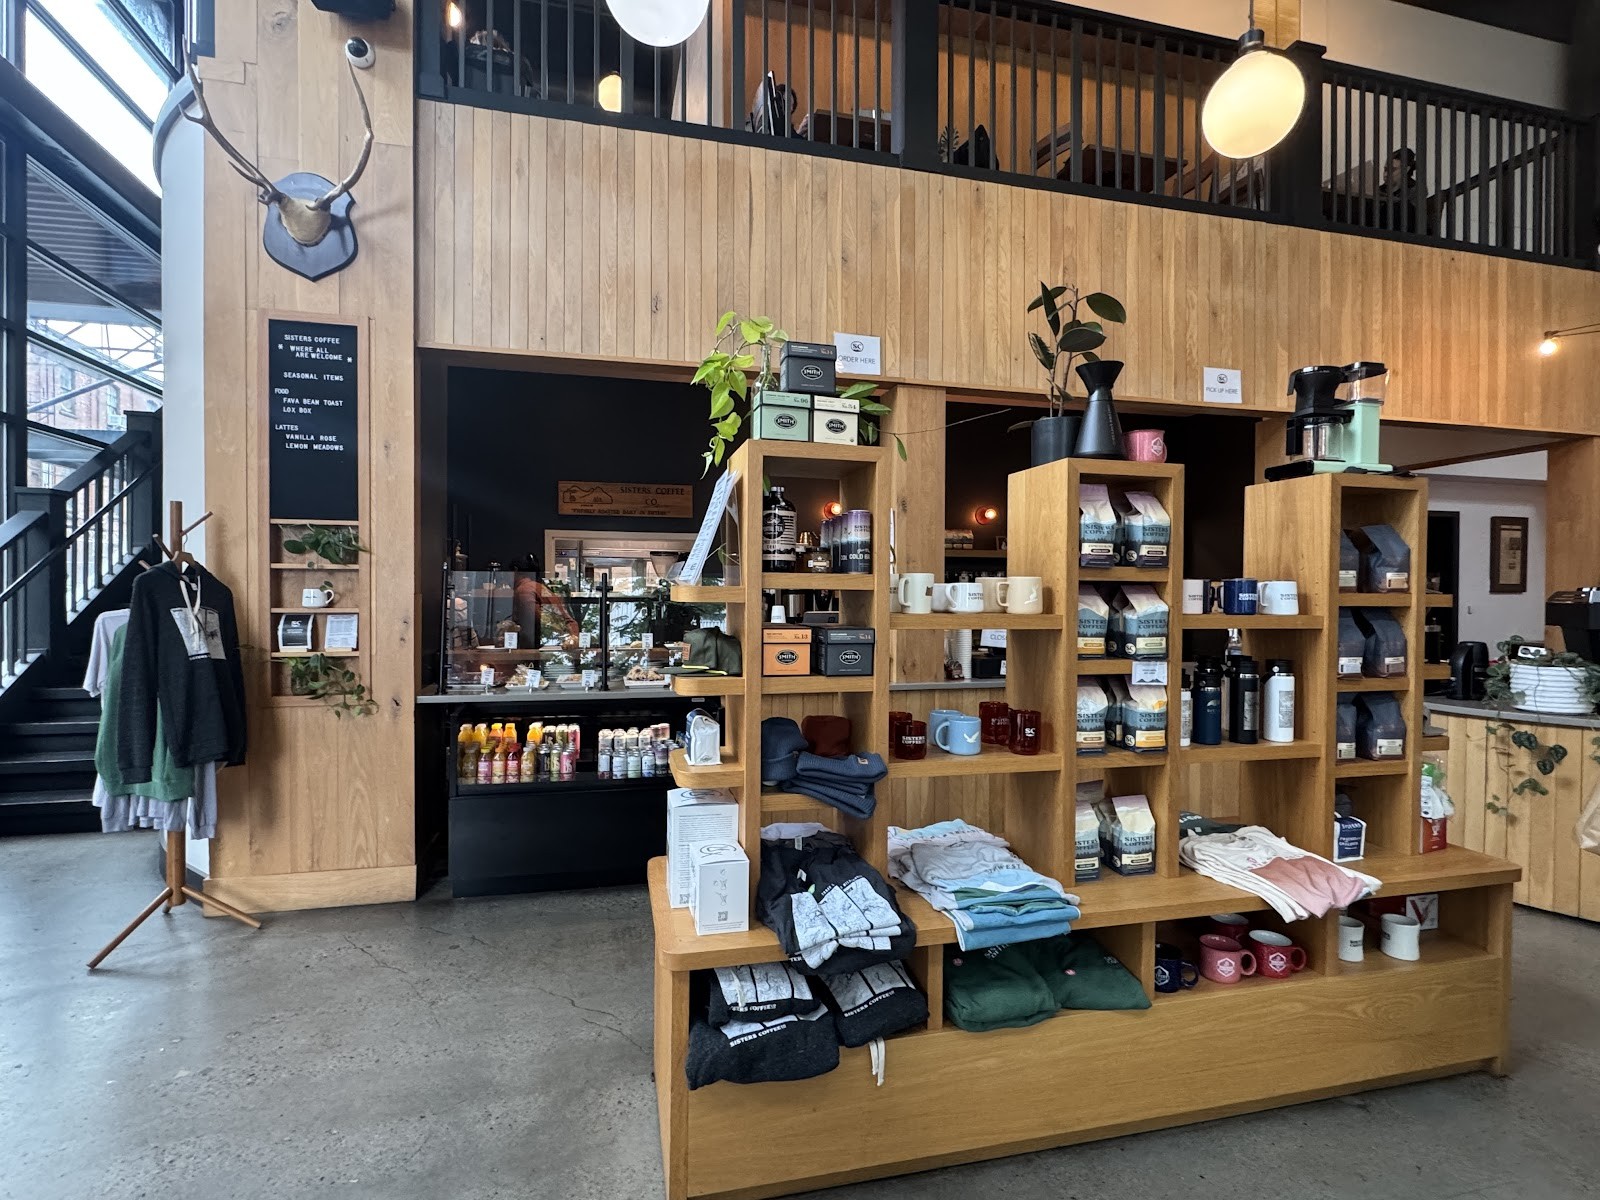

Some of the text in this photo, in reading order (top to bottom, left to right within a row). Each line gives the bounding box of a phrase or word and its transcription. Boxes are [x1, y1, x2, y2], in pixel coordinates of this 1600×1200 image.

[284, 334, 312, 342] SISTERS
[284, 372, 318, 380] SEASONAL
[620, 486, 651, 494] SISTERS
[844, 992, 890, 1018] SISTERS COFFEE
[729, 1025, 781, 1047] SISTERS COFFEE
